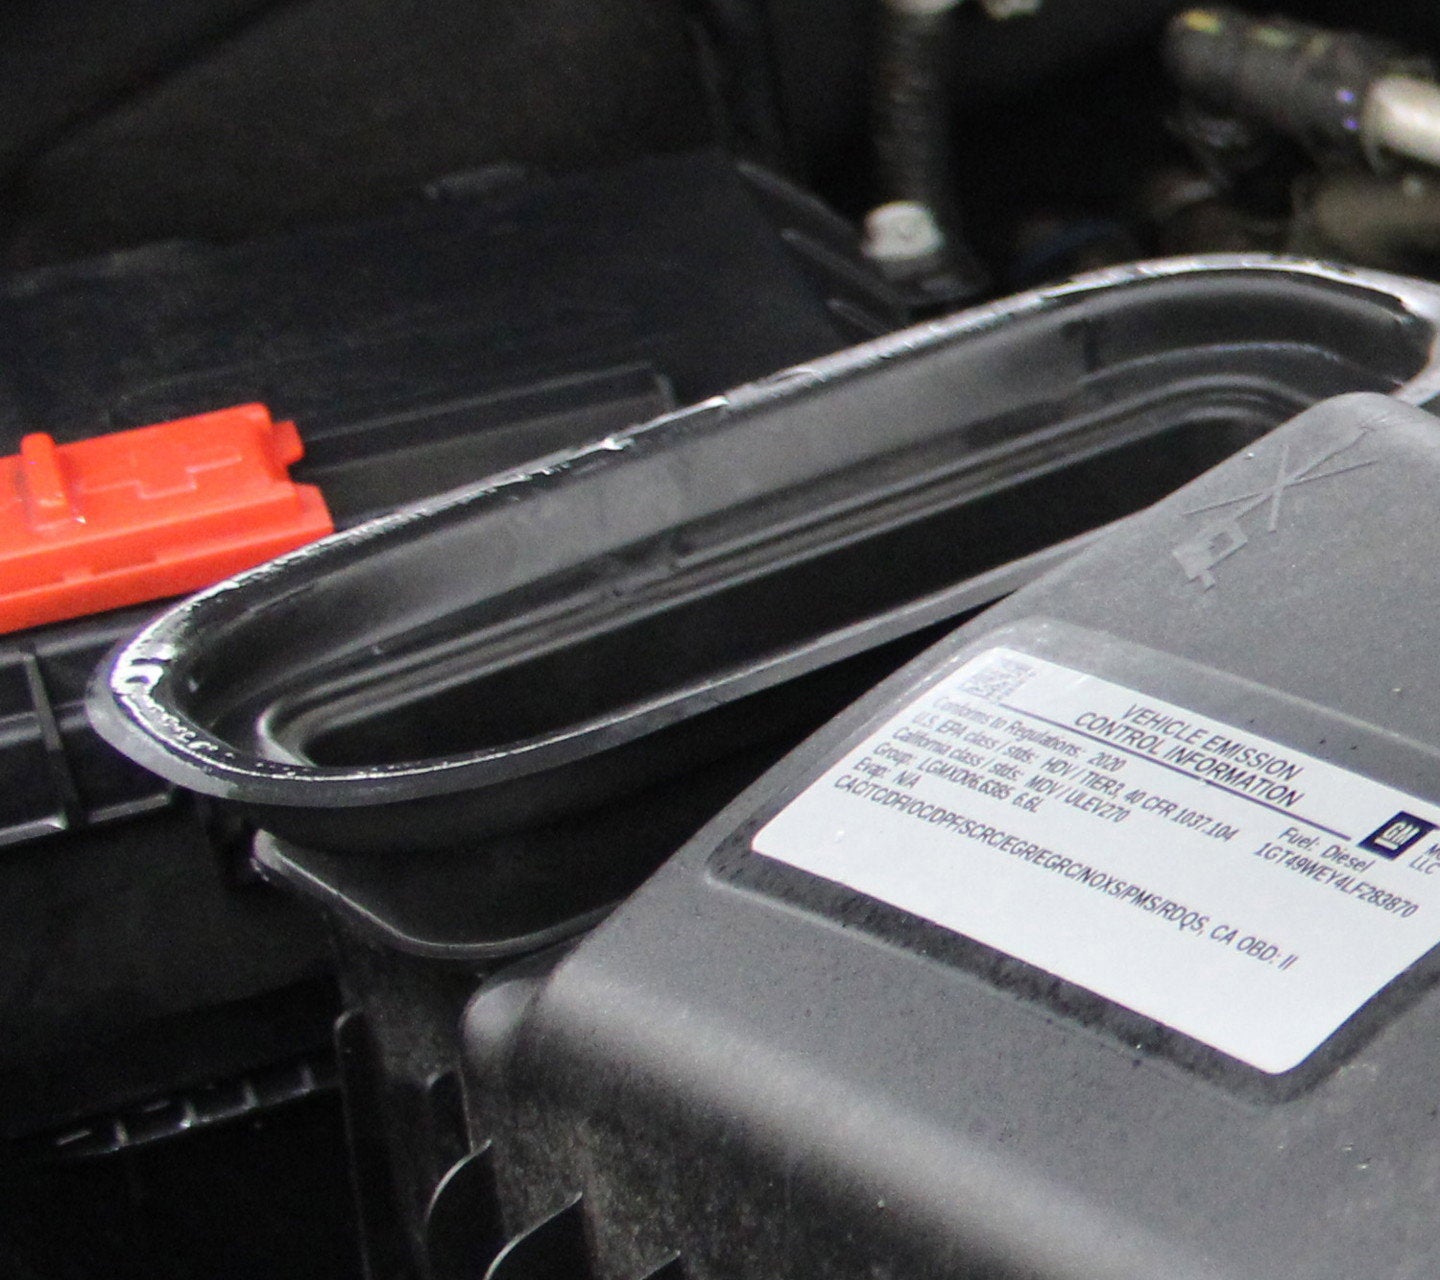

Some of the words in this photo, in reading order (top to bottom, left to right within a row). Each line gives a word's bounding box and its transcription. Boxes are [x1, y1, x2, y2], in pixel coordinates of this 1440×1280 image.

[853, 756, 891, 779] Evap:
[873, 742, 917, 766] Group:
[1012, 792, 1044, 813] 6.6L
[892, 727, 952, 756] California
[948, 747, 985, 767] class
[988, 762, 1024, 782] stds:
[1024, 774, 1064, 795] MDV
[1064, 790, 1131, 823] ULEV270
[911, 712, 940, 729] U.S.
[935, 719, 968, 738] EPA
[963, 731, 1000, 750] class
[1002, 745, 1039, 764] stds:
[1040, 757, 1078, 777] HDV
[1080, 771, 1126, 799] TIER3,
[1124, 789, 1147, 805] 40
[1141, 796, 1179, 817] CFR
[1172, 808, 1239, 842] 1037.104
[988, 716, 1008, 730] to
[1005, 720, 1085, 763] Regulations:
[1087, 751, 1127, 772] 2020
[1075, 712, 1165, 755] CONTROL
[1164, 746, 1303, 807] INFORMATION
[1122, 704, 1208, 745] VEHICLE
[1201, 735, 1303, 781] EMISSION
[1278, 826, 1320, 851] Fuel:
[1320, 844, 1375, 872] Diesel
[1210, 924, 1239, 945] CA
[1236, 936, 1280, 964] OBD:
